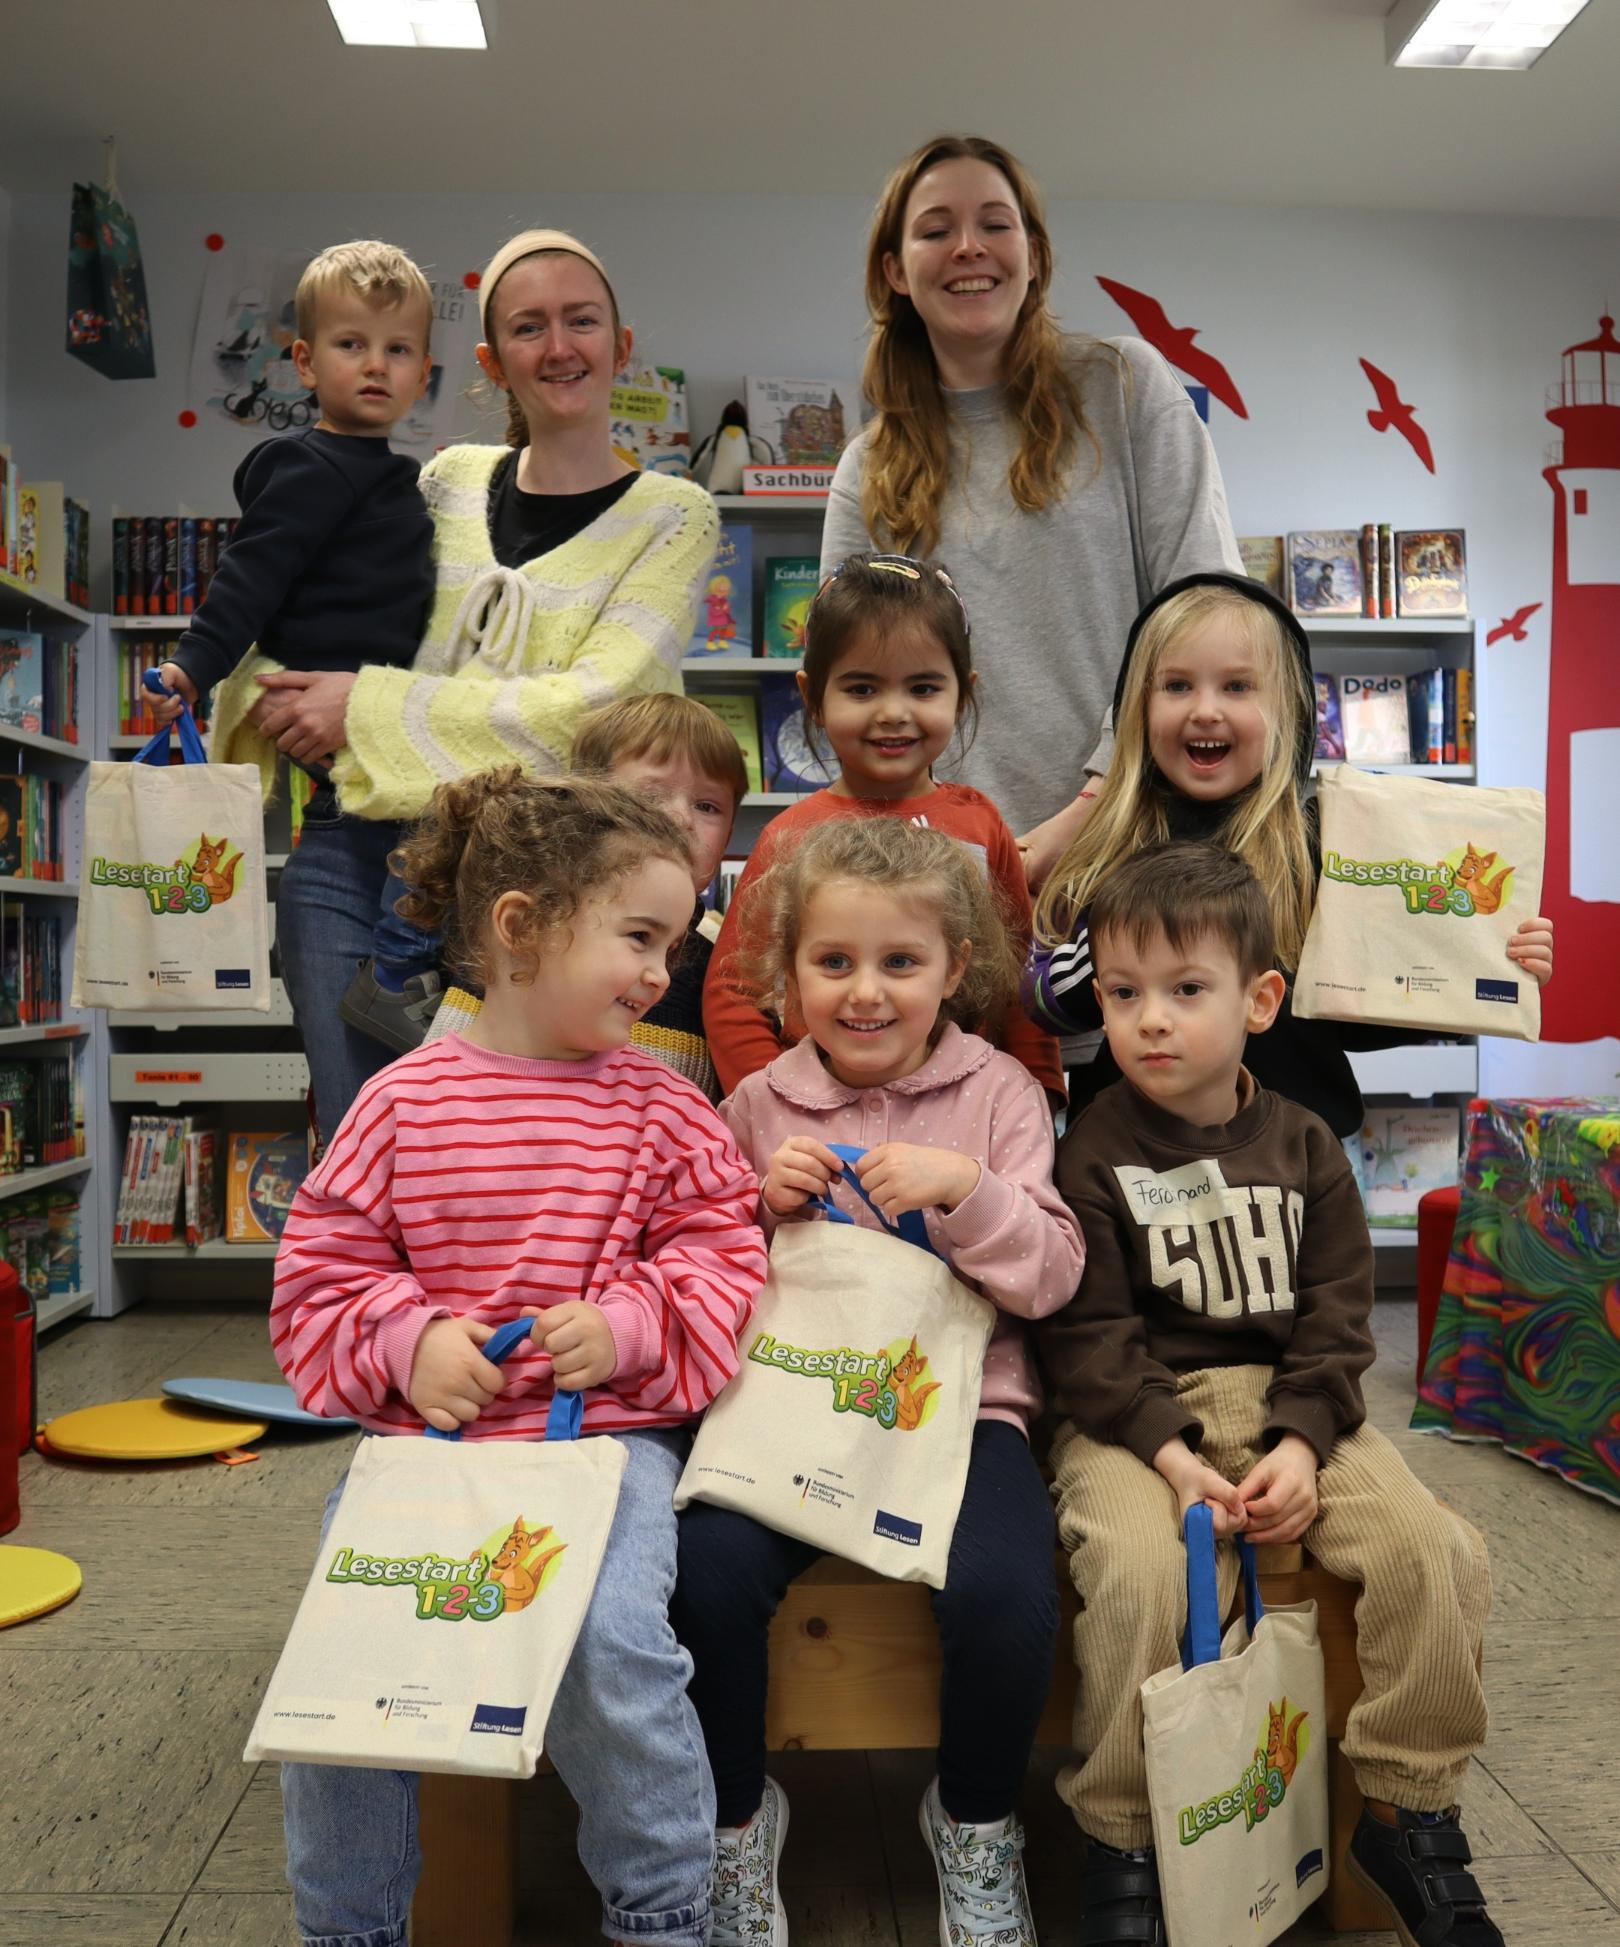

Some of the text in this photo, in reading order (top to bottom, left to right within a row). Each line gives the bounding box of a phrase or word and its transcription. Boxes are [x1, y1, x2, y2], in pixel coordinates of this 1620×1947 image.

[1344, 677, 1402, 695] Dodo
[93, 860, 186, 884] Lesetart
[1328, 853, 1450, 884] Lesestart
[150, 885, 206, 909] 1-2-3
[1407, 885, 1472, 912] 1-2-3
[753, 1337, 887, 1380] Lesestart
[837, 1378, 896, 1422] 1-2-3
[698, 1466, 756, 1485] www.lesestart.de
[875, 1526, 918, 1544] Stiftung Lesen
[331, 1551, 482, 1581] Lesestart
[421, 1584, 500, 1614] 1-2-3
[273, 1711, 336, 1721] www.lesestart.de
[473, 1722, 522, 1734] Stiftung Lesen
